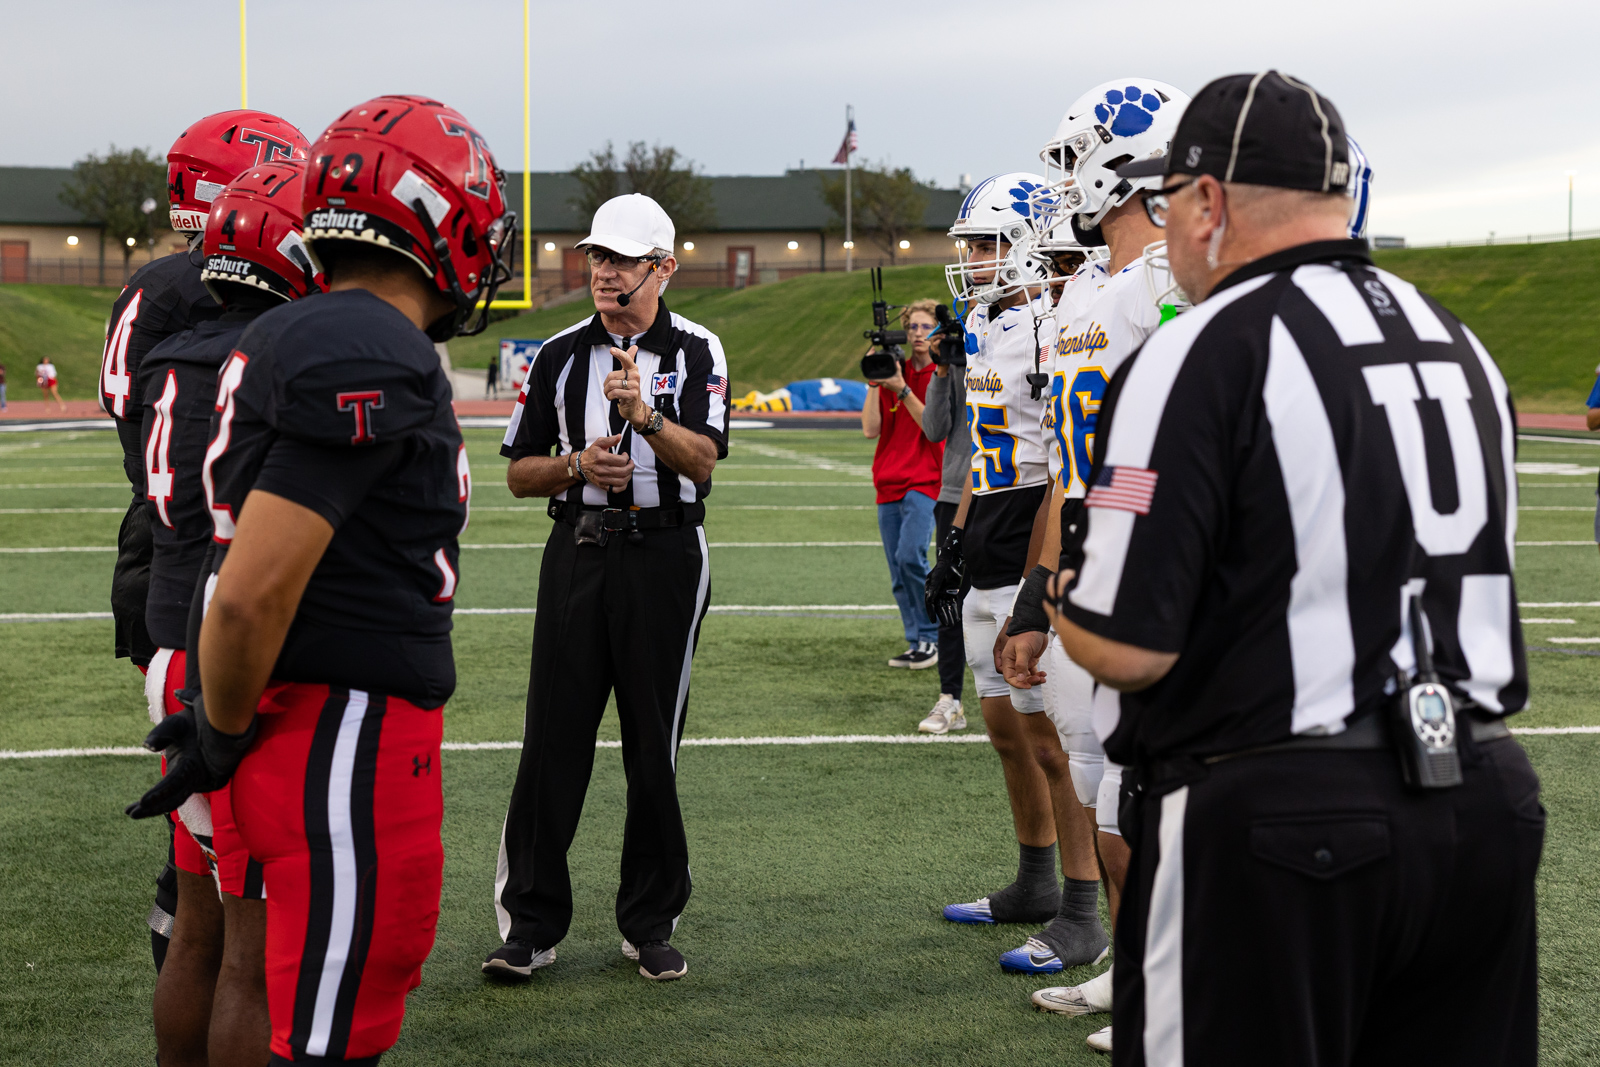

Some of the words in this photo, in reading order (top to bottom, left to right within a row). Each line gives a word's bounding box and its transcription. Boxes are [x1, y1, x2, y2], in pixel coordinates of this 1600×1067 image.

[316, 152, 364, 196] 12
[436, 114, 495, 200] T
[1185, 145, 1202, 168] S
[221, 209, 238, 243] 4
[311, 207, 368, 230] schutt
[207, 255, 252, 276] schutt
[1363, 279, 1391, 309] S
[98, 286, 143, 421] 4
[336, 390, 385, 446] T
[145, 368, 176, 531] 4
[202, 349, 251, 545] 2
[1362, 362, 1488, 557] U
